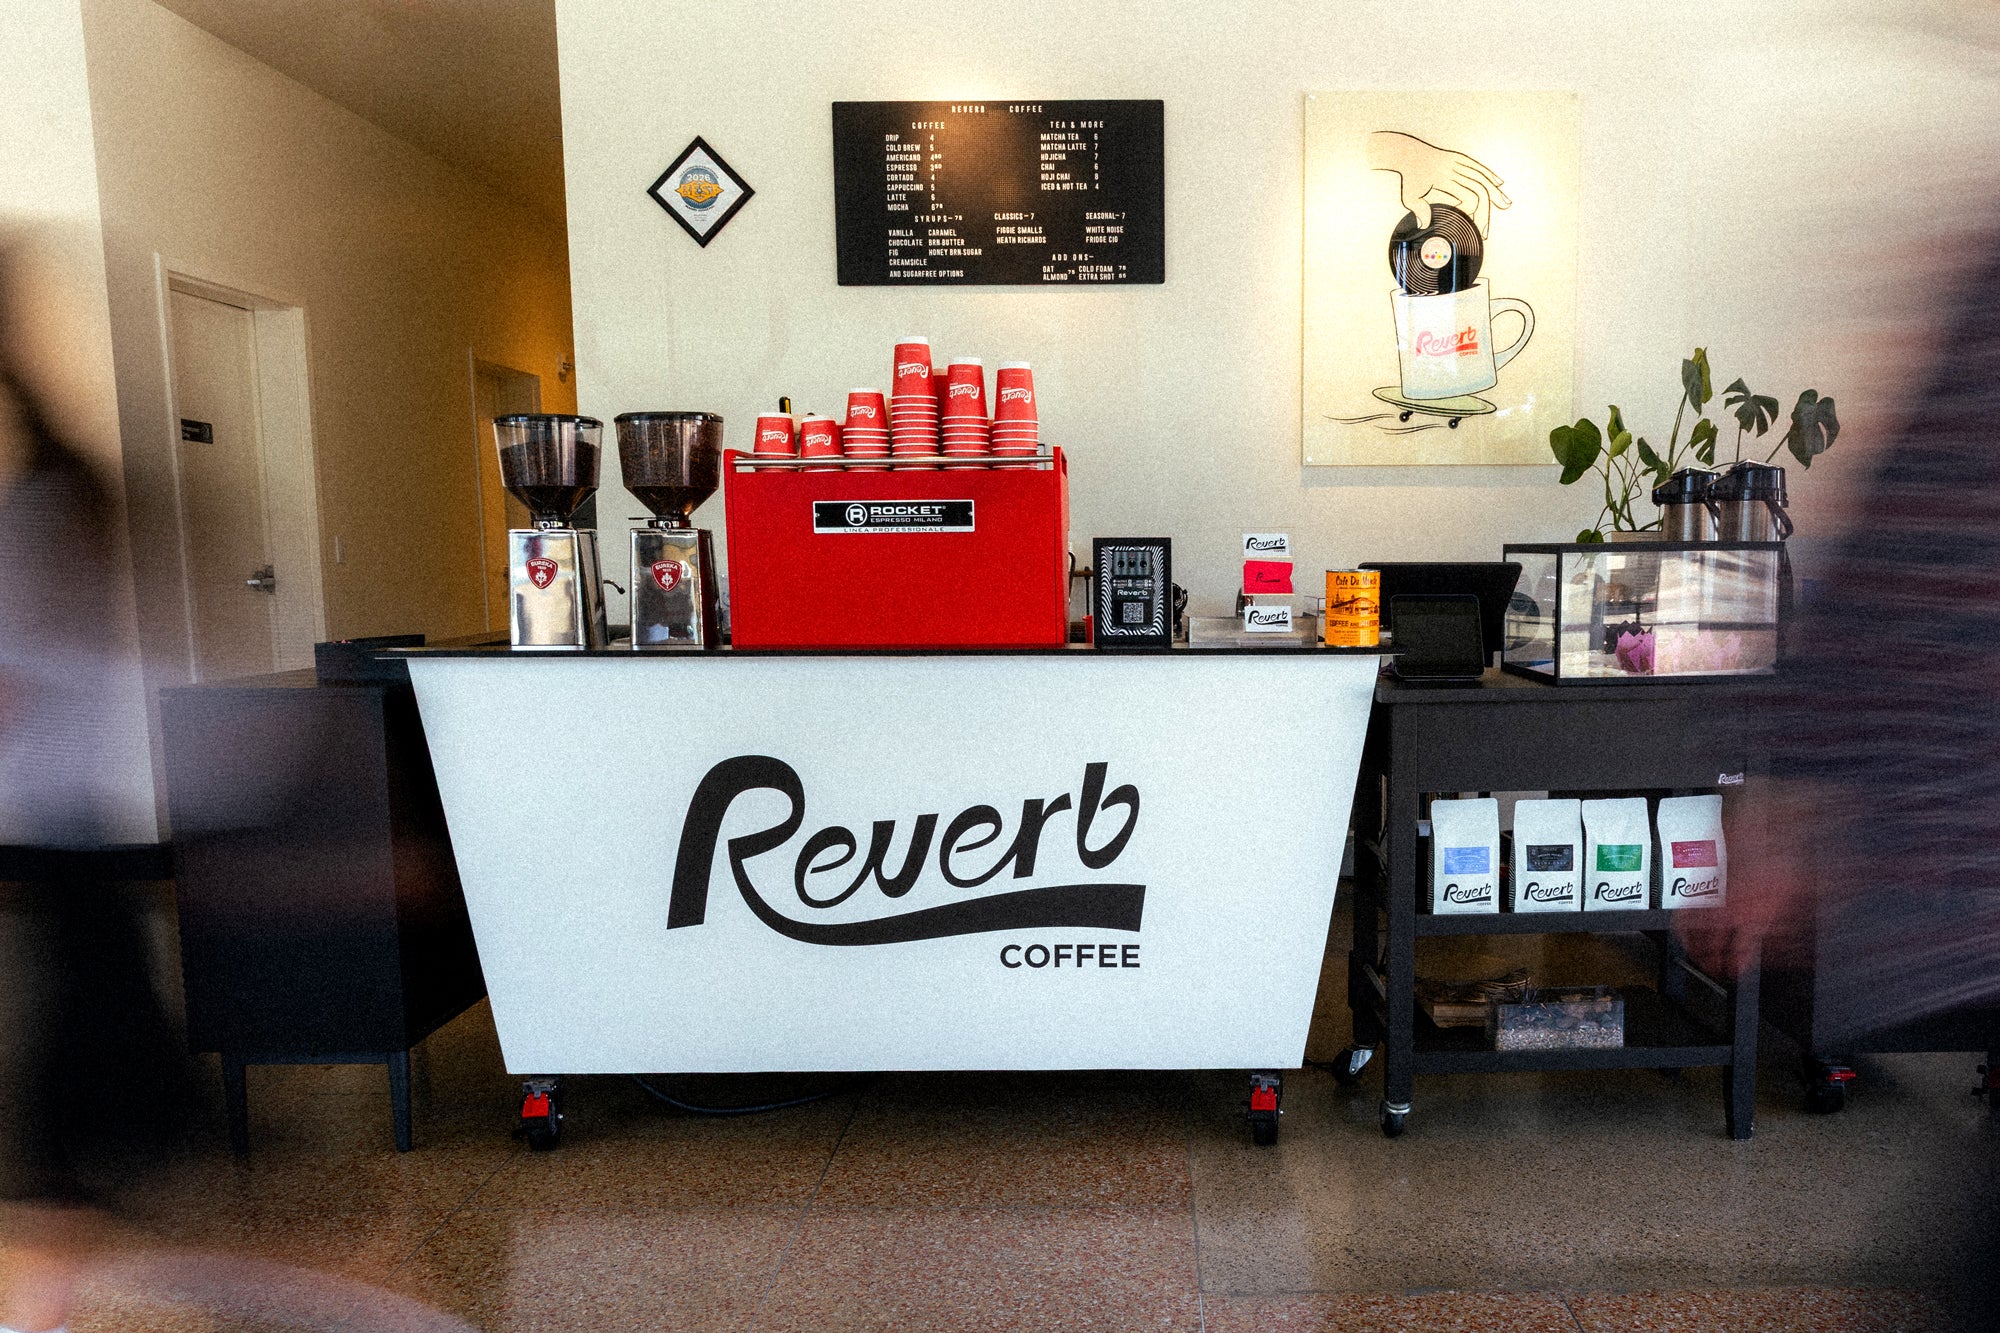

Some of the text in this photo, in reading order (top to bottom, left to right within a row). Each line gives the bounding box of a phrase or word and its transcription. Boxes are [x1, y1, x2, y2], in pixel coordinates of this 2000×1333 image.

[1416, 326, 1478, 356] Reverb
[898, 363, 928, 378] Reverb
[949, 384, 979, 399] Reverb
[1002, 388, 1032, 404] Reverb
[851, 406, 876, 418] Reverb
[762, 431, 788, 443] Reverb
[806, 434, 832, 447] Reverb
[1246, 537, 1286, 550] Reverb
[1248, 610, 1288, 625] Reverb
[666, 754, 1146, 946] Reverb
[1443, 883, 1491, 904] Reverb
[1524, 882, 1573, 902] Reverb
[1594, 881, 1642, 902] Reverb
[1671, 876, 1718, 897] Reverb
[1000, 944, 1140, 969] COFFEE
